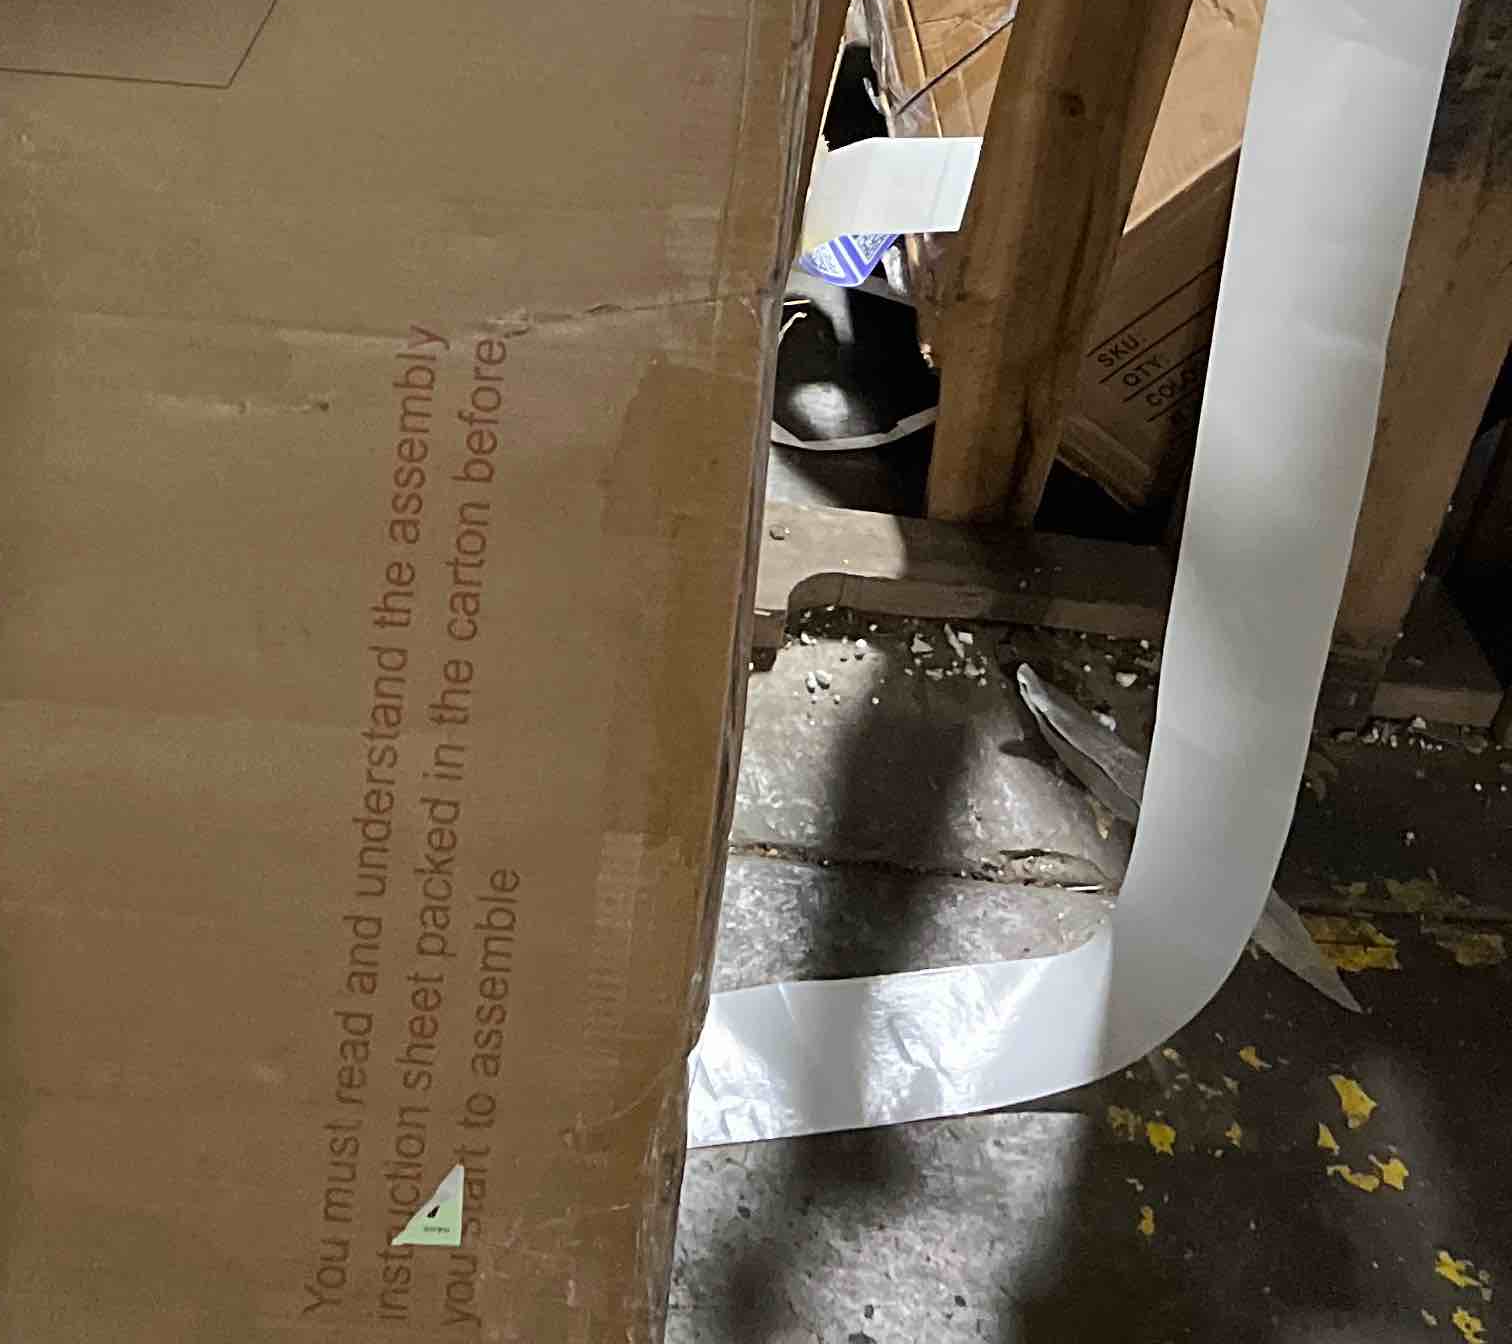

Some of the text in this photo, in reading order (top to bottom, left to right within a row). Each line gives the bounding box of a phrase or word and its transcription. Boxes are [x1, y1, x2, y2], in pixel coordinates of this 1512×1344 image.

[1096, 333, 1147, 369] SKU:
[301, 324, 450, 1315] You must read and understand the assembly
[379, 337, 507, 1321] instuction sheet packed in the carton before
[470, 867, 521, 1078] assemble
[459, 1092, 497, 1131] to
[439, 1254, 483, 1330] you
